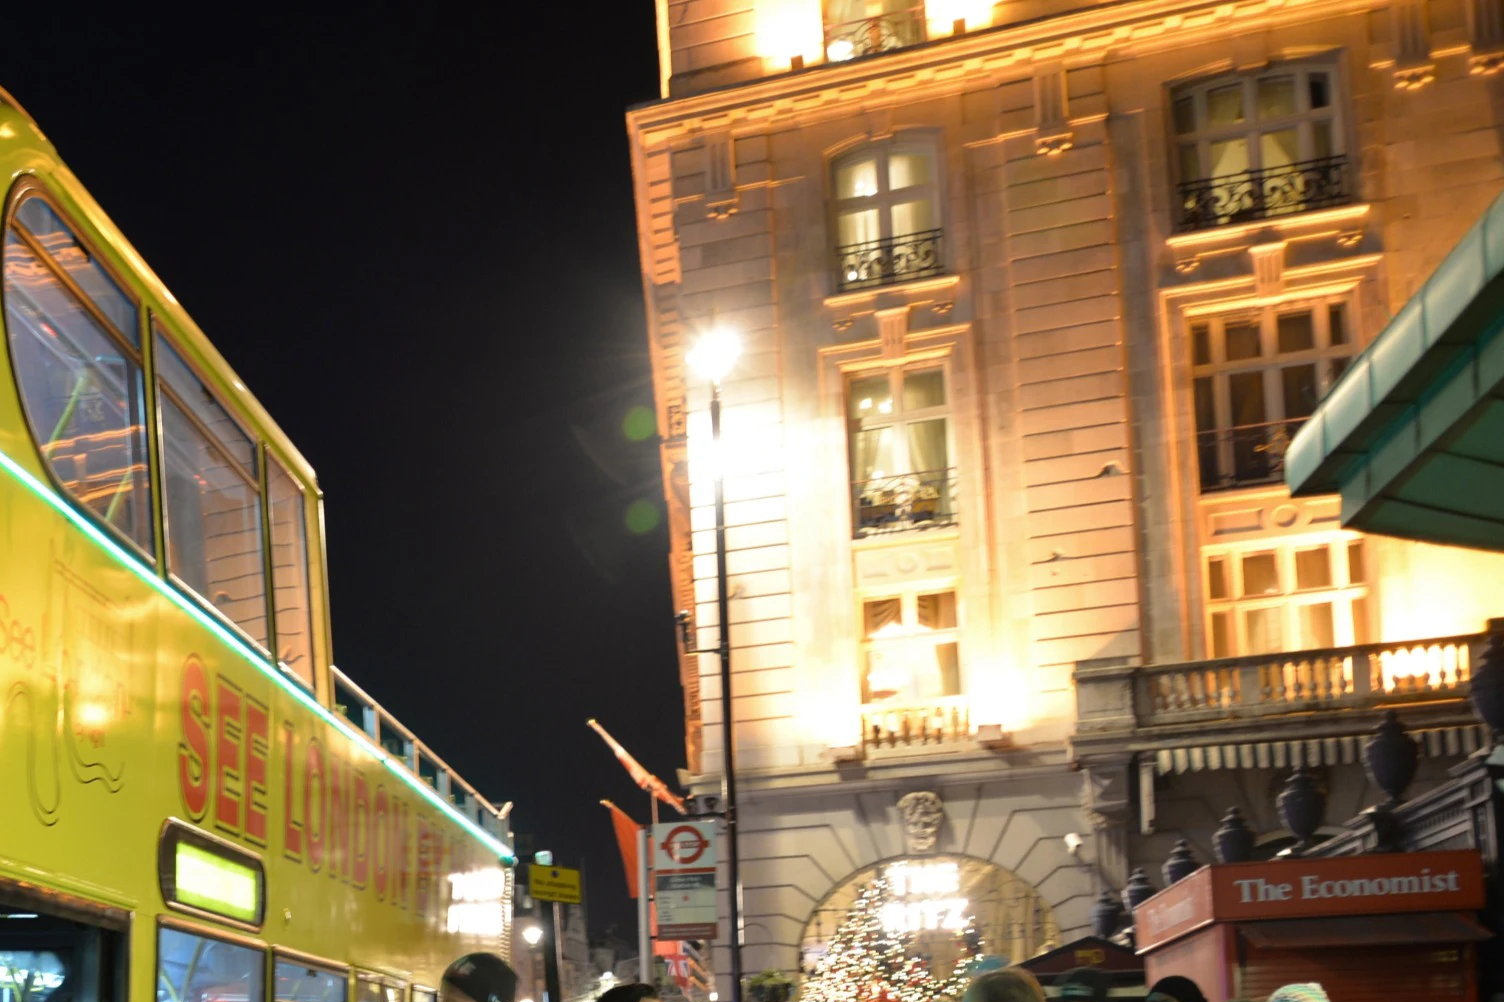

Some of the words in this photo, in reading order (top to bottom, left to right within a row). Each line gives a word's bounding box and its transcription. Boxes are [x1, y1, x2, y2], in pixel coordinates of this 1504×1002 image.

[178, 652, 270, 850] SEE
[283, 718, 410, 911] LONDON
[1233, 878, 1294, 903] The
[1299, 868, 1461, 900] Economist
